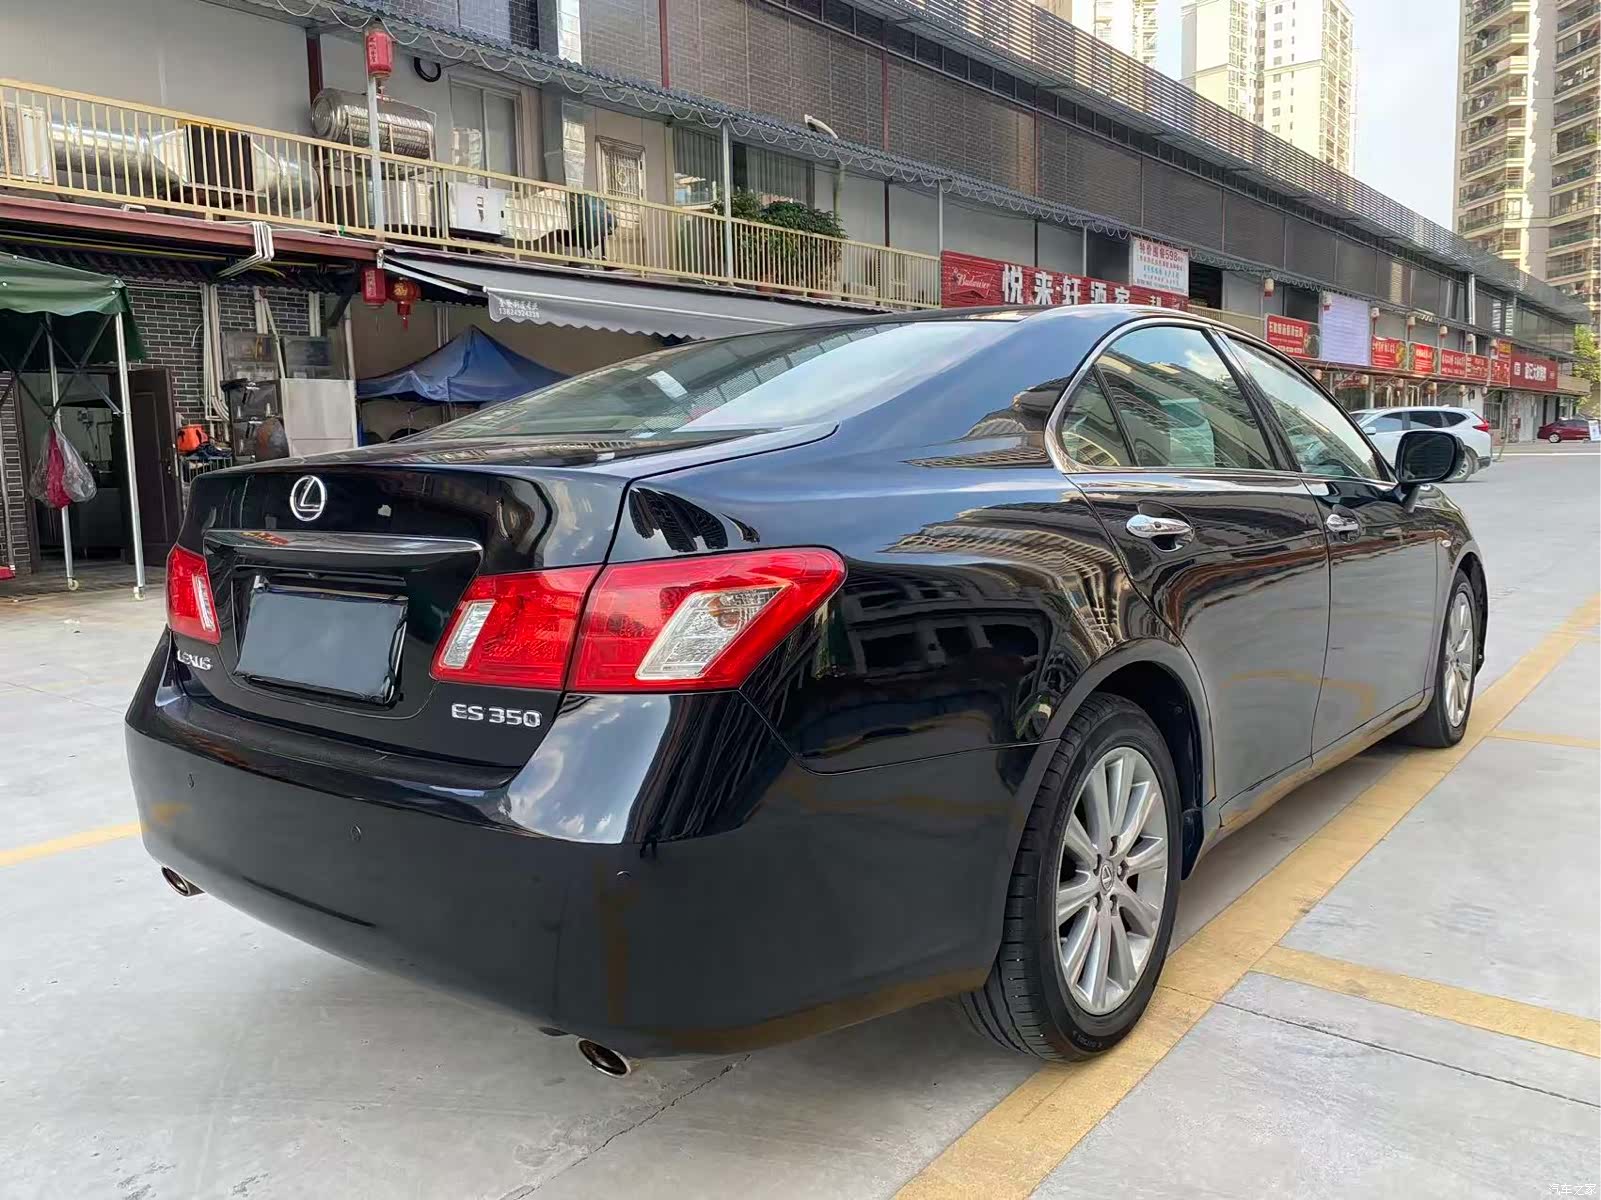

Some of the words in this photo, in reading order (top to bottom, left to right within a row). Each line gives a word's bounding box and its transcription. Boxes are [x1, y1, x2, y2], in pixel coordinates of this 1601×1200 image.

[955, 270, 991, 289] Budweiser
[451, 703, 484, 721] ES
[488, 706, 542, 728] 350
